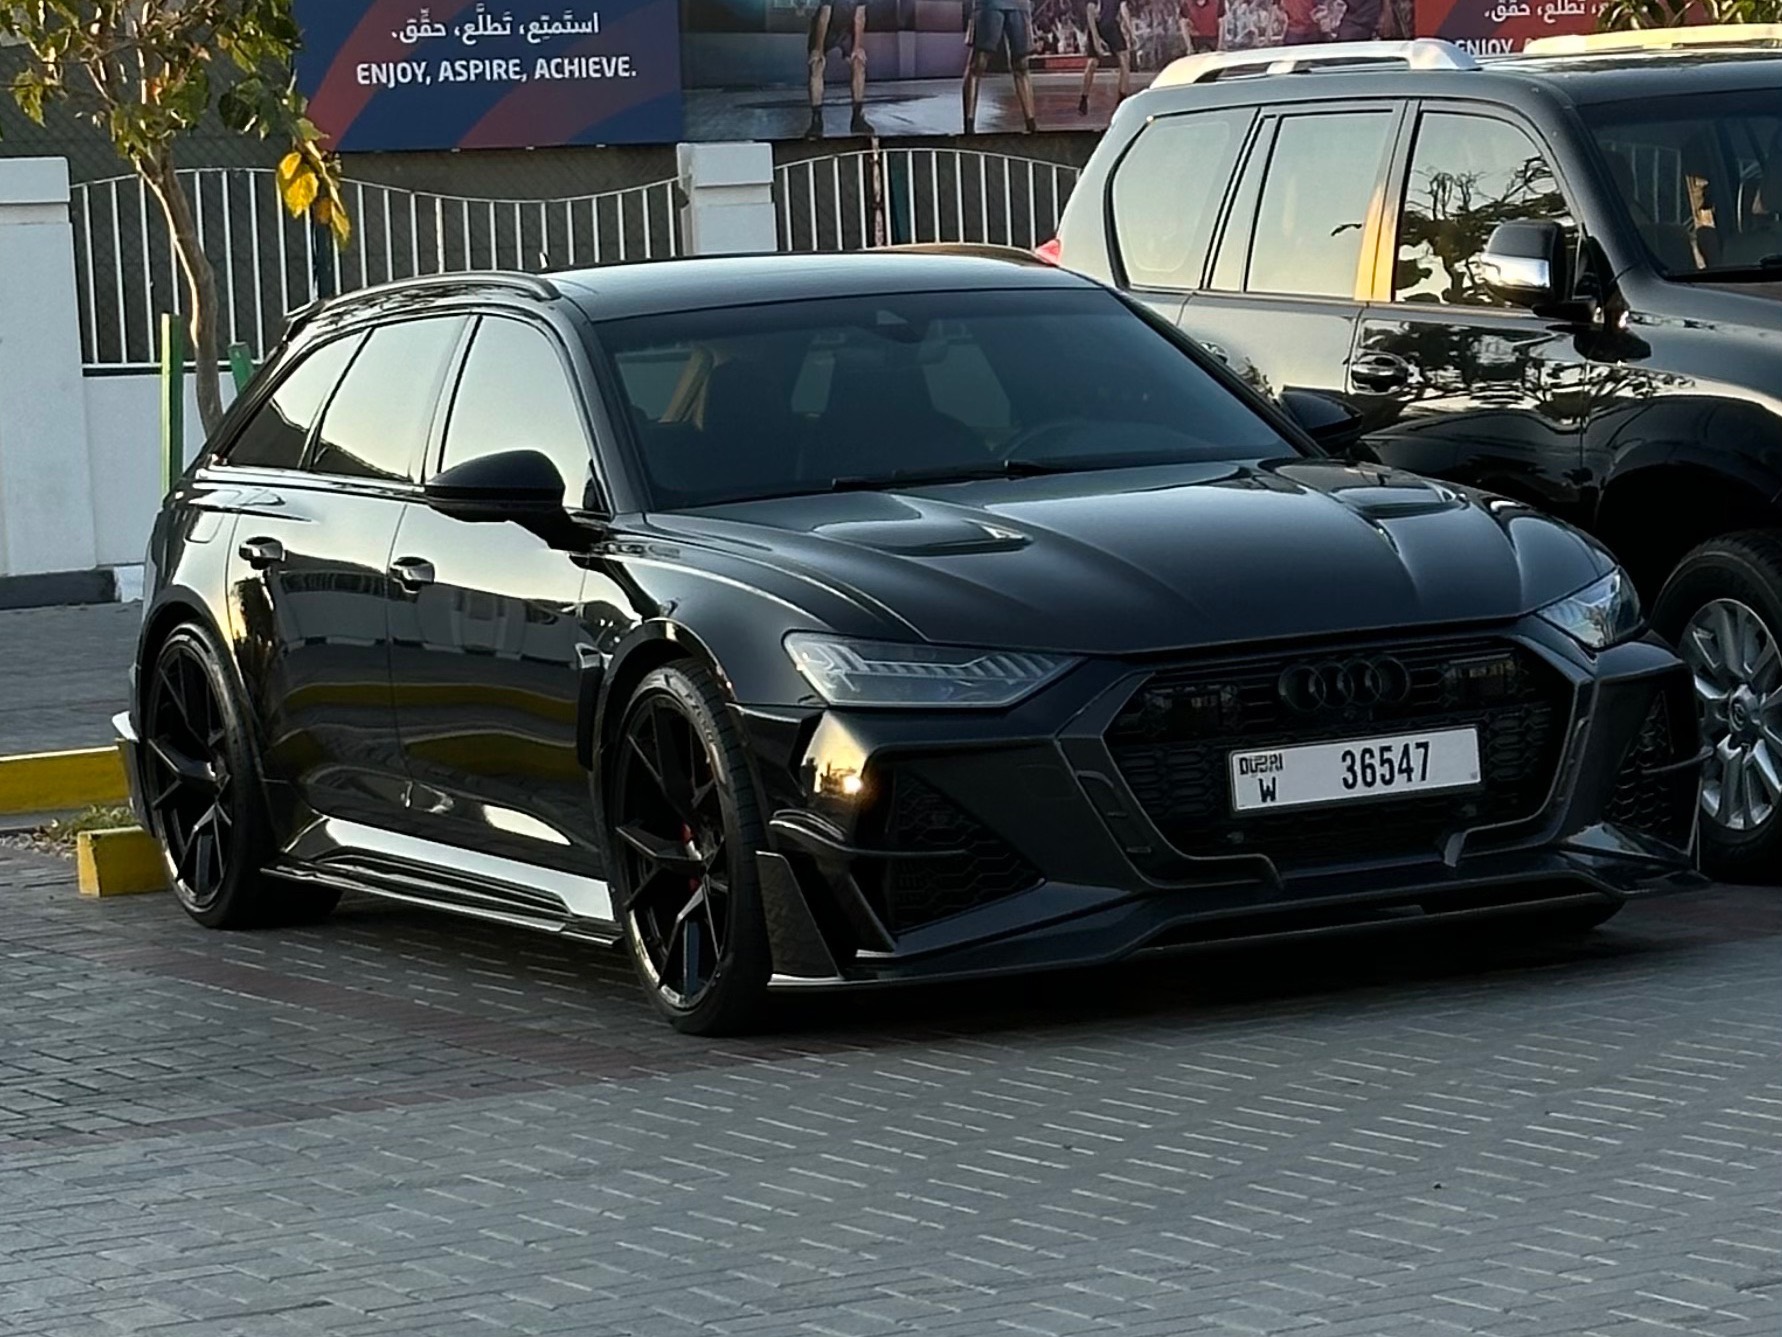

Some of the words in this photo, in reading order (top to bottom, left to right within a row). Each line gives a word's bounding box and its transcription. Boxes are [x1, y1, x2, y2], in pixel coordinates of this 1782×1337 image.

[356, 60, 431, 89] ENJOY,
[438, 58, 527, 83] ASPIRE,
[534, 56, 637, 80] ACHIEVE.
[1341, 741, 1430, 790] 36547
[1258, 776, 1276, 803] W
